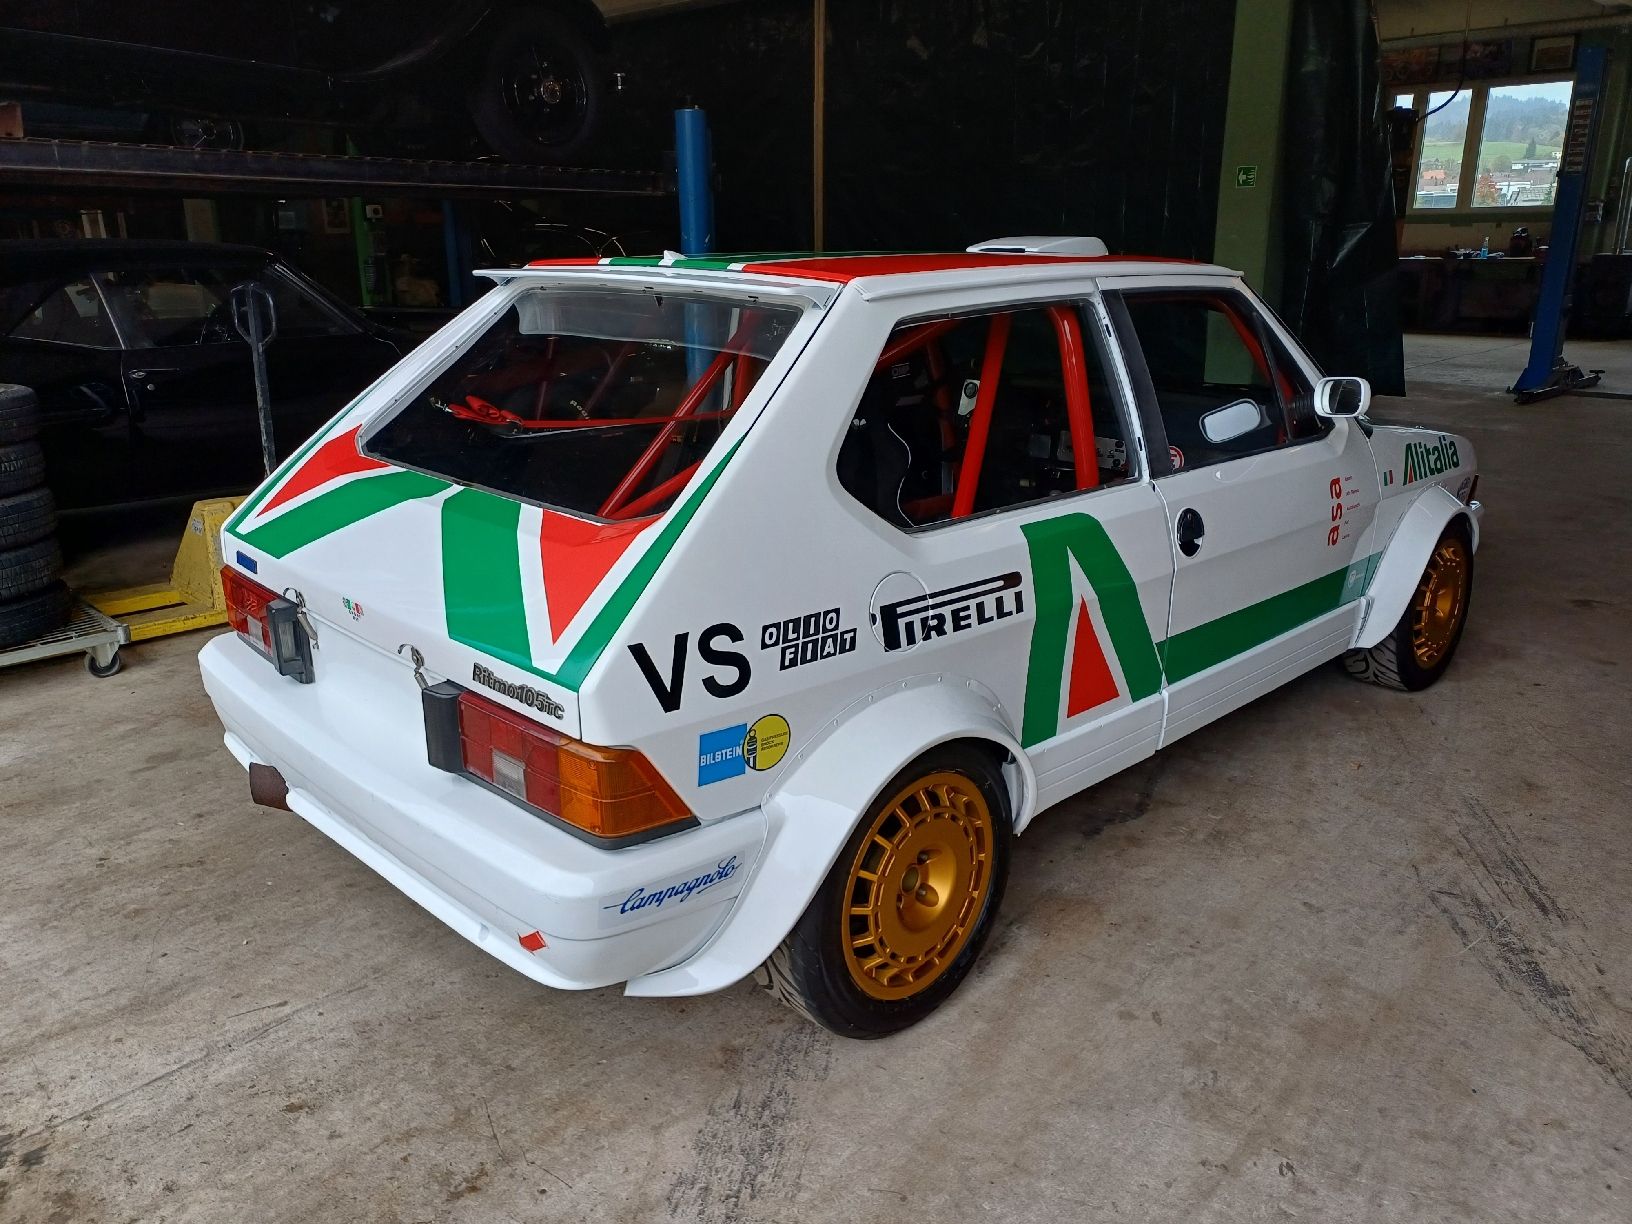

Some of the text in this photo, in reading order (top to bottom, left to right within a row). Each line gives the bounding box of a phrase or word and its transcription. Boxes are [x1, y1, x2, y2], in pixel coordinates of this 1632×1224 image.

[1402, 435, 1460, 486] Alitalia
[1327, 476, 1342, 547] asa
[760, 607, 841, 650] OLIO
[879, 571, 1024, 653] PIRELLI
[627, 622, 752, 714] VS
[779, 628, 858, 672] FIAT
[700, 744, 744, 767] BILSTEIN
[606, 855, 741, 915] Campagnolo
